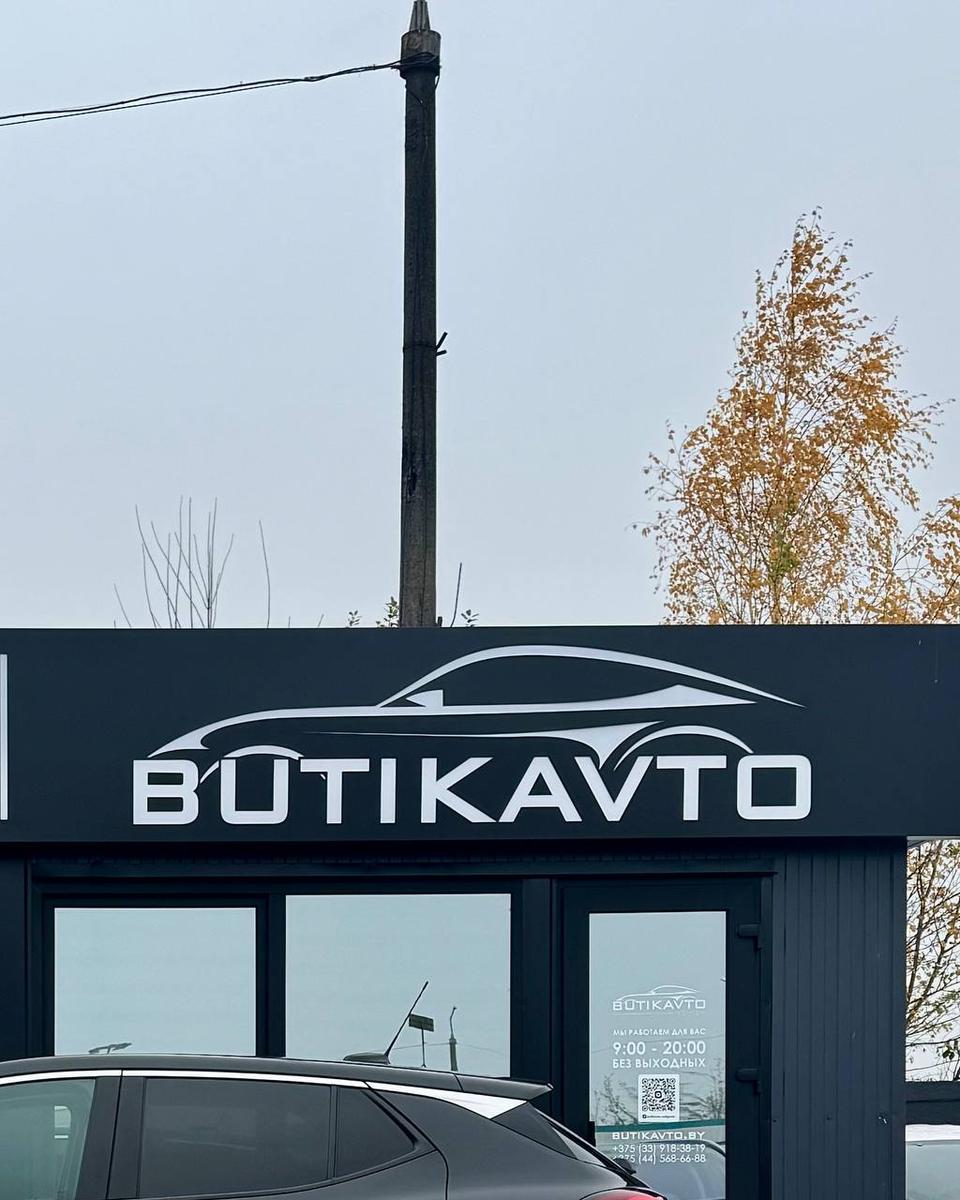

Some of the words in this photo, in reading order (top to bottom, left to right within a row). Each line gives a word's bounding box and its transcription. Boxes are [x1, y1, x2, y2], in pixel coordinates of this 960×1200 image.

[132, 754, 813, 825] BUTIKAVTO
[612, 999, 706, 1011] BUTIKAVTO
[671, 1028, 688, 1036] ДЛЯ
[612, 1041, 646, 1055] 9:00
[663, 1041, 706, 1055] 20:00
[612, 1058, 632, 1069] БЕЗ
[635, 1058, 706, 1069] ВЫХОДНЫХ
[612, 1131, 706, 1140] BUTIKAVTO.BY
[612, 1144, 636, 1153] +375
[638, 1144, 656, 1154] (33)
[659, 1144, 706, 1153] 918-38-19
[638, 1154, 656, 1165] (44)
[659, 1154, 706, 1163] 568-66-88
